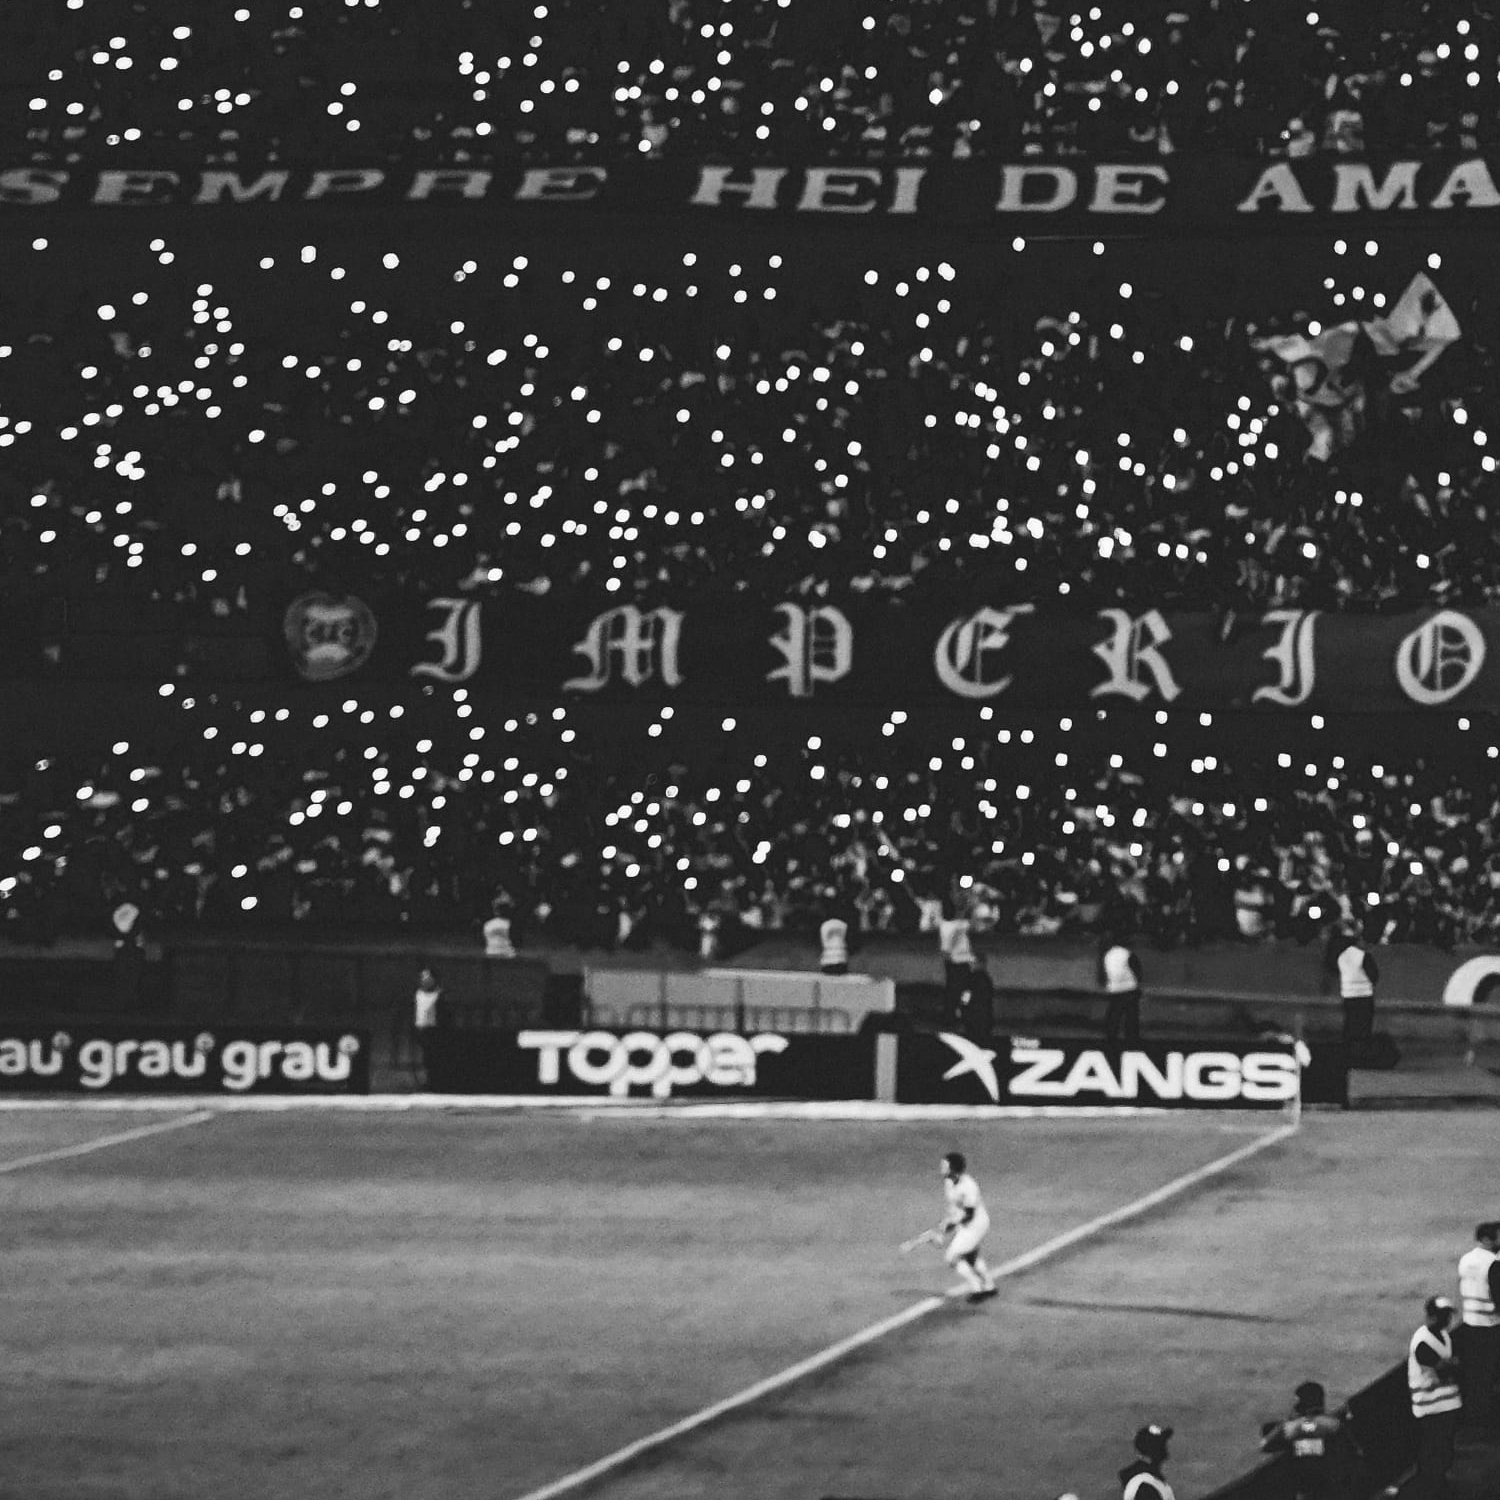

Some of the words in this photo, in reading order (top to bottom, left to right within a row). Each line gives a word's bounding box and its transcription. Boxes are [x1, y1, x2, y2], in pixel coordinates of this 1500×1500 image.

[0, 169, 607, 205] SEMPRE
[690, 165, 927, 214] HEI
[996, 164, 1171, 214] DE
[79, 1038, 208, 1088] grau
[221, 1039, 351, 1089] grau
[1008, 1049, 1299, 1101] ZANGS
